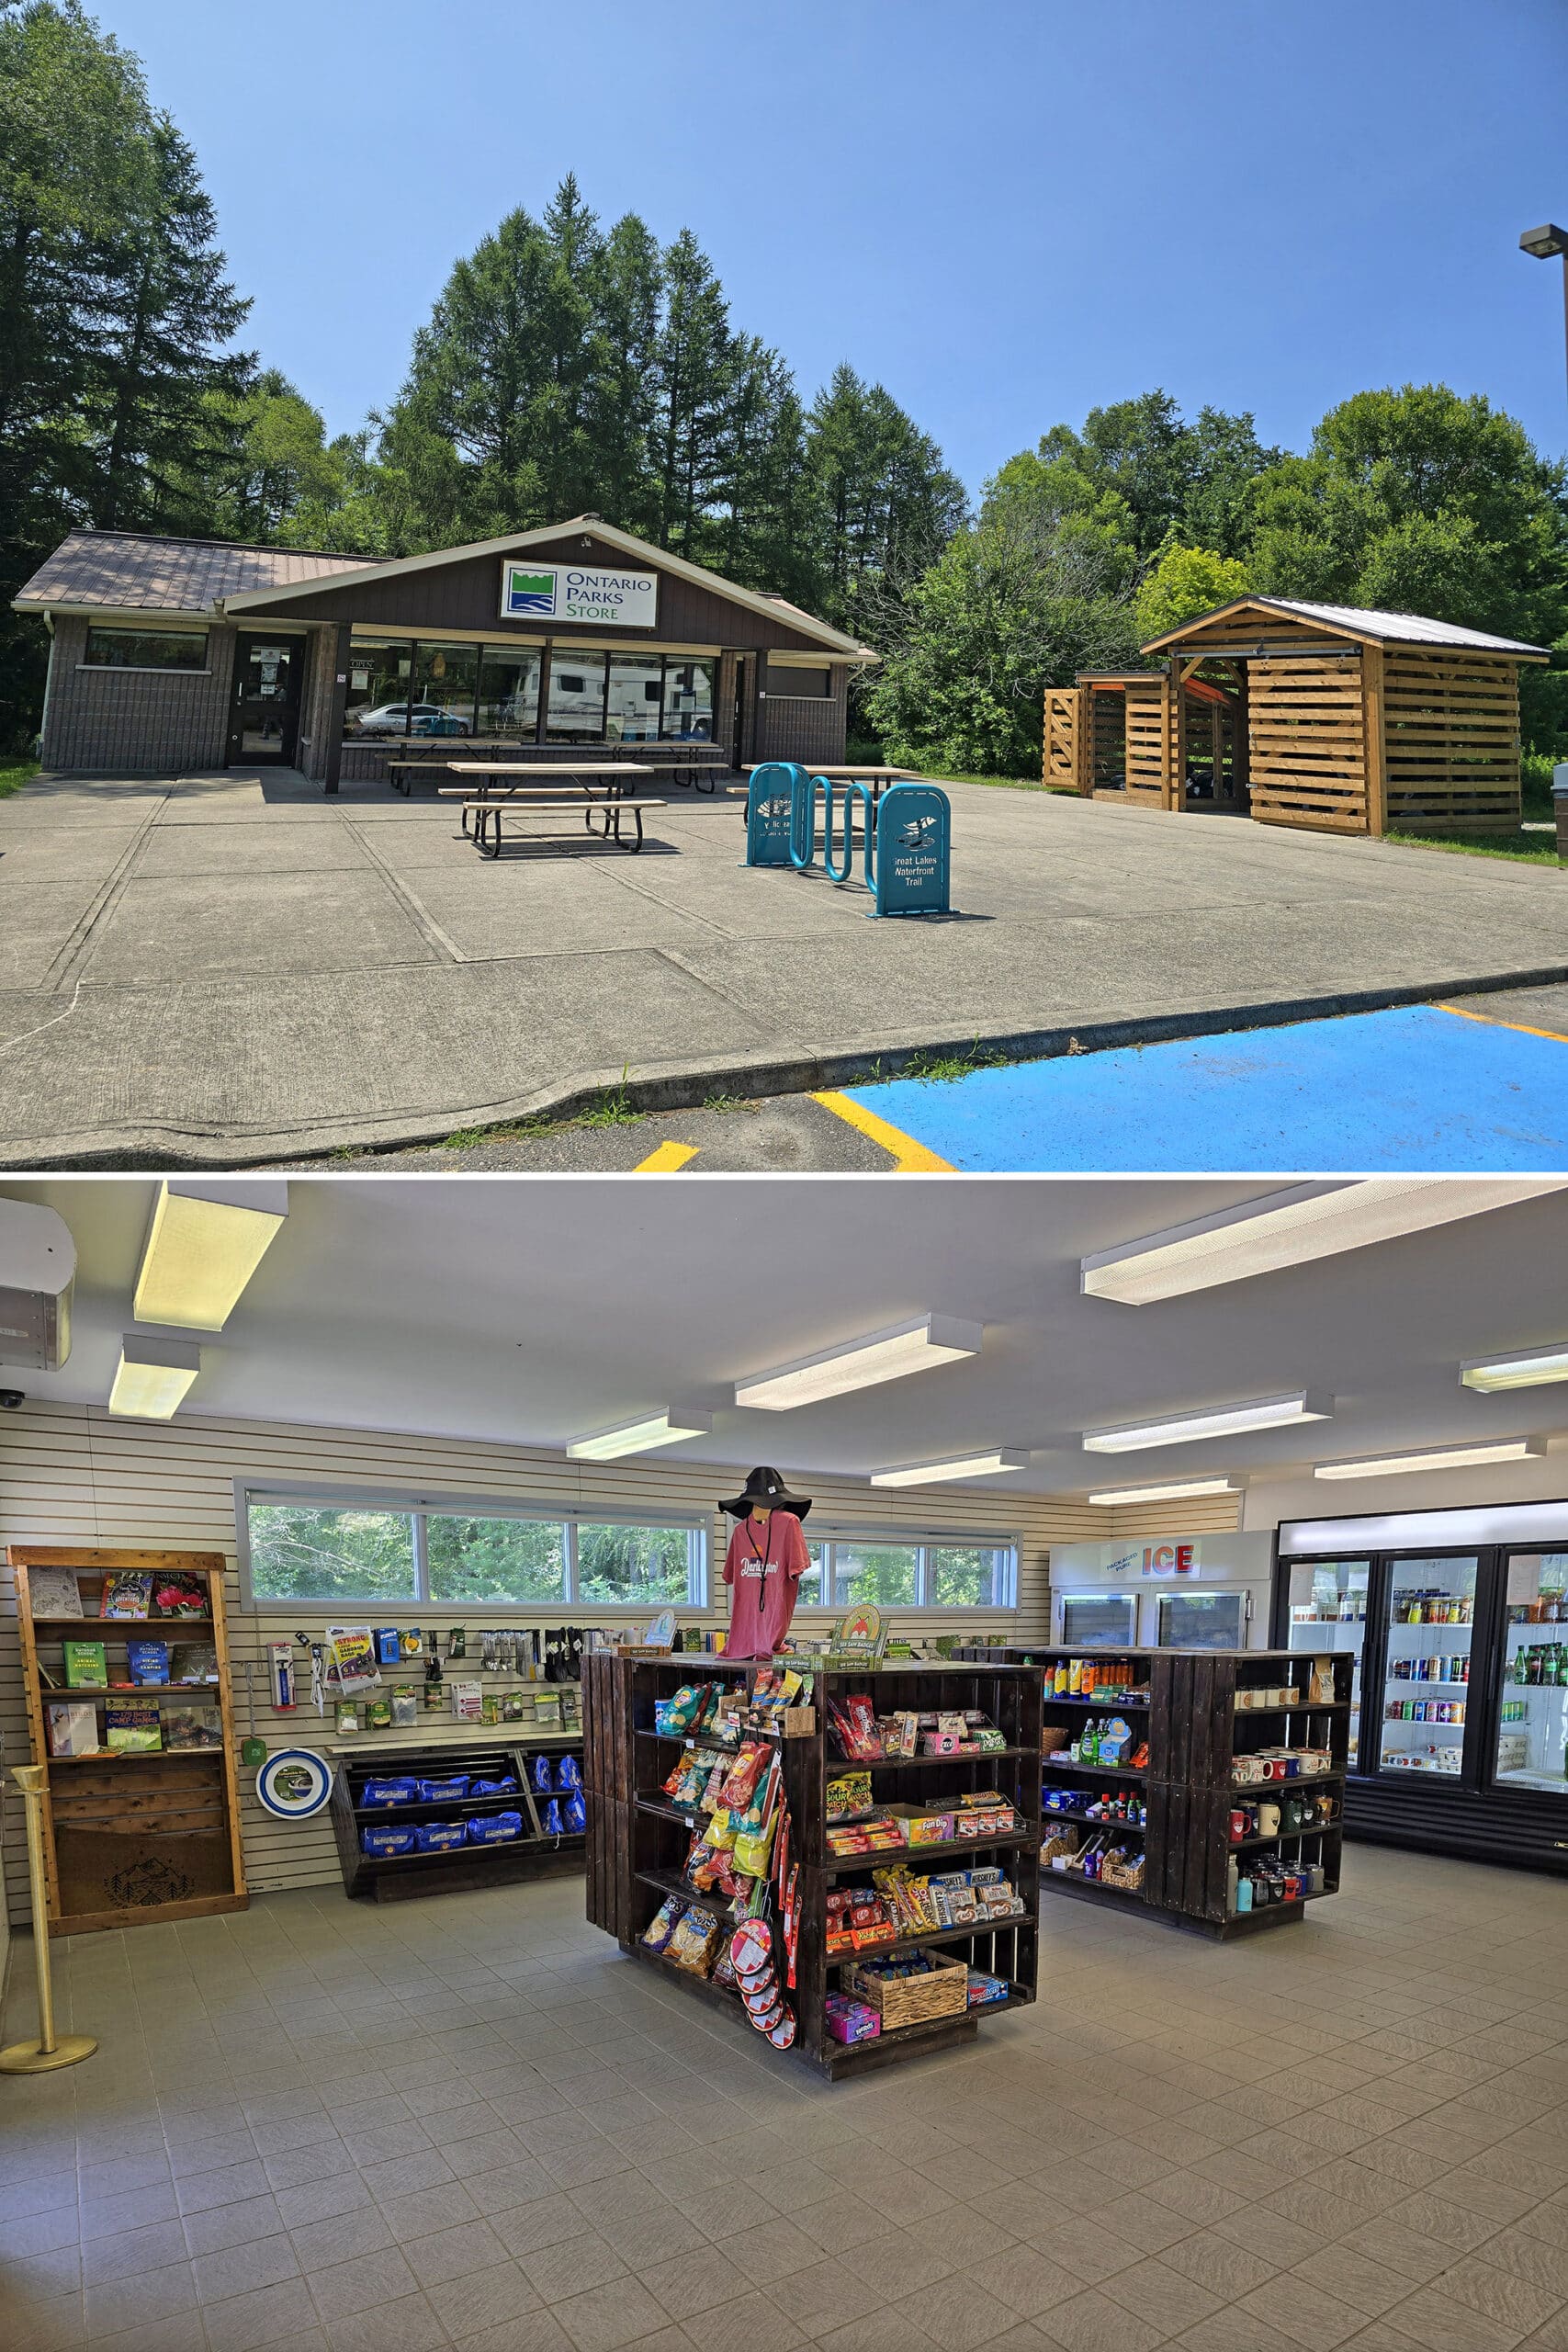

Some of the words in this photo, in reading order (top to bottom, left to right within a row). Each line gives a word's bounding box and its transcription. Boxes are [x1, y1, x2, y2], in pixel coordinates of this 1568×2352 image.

[566, 572, 652, 592] ONTARIO
[566, 587, 624, 605] PARKS
[566, 604, 619, 620] STORE
[915, 855, 937, 865] Lakes
[905, 876, 922, 886] Trail
[1142, 1544, 1194, 1576] ICE
[852, 1784, 868, 1793] OUR
[826, 1792, 848, 1801] SOUR
[922, 1820, 935, 1829] Fun
[935, 1819, 947, 1829] Dip
[971, 1871, 996, 1883] HERSHEY'S
